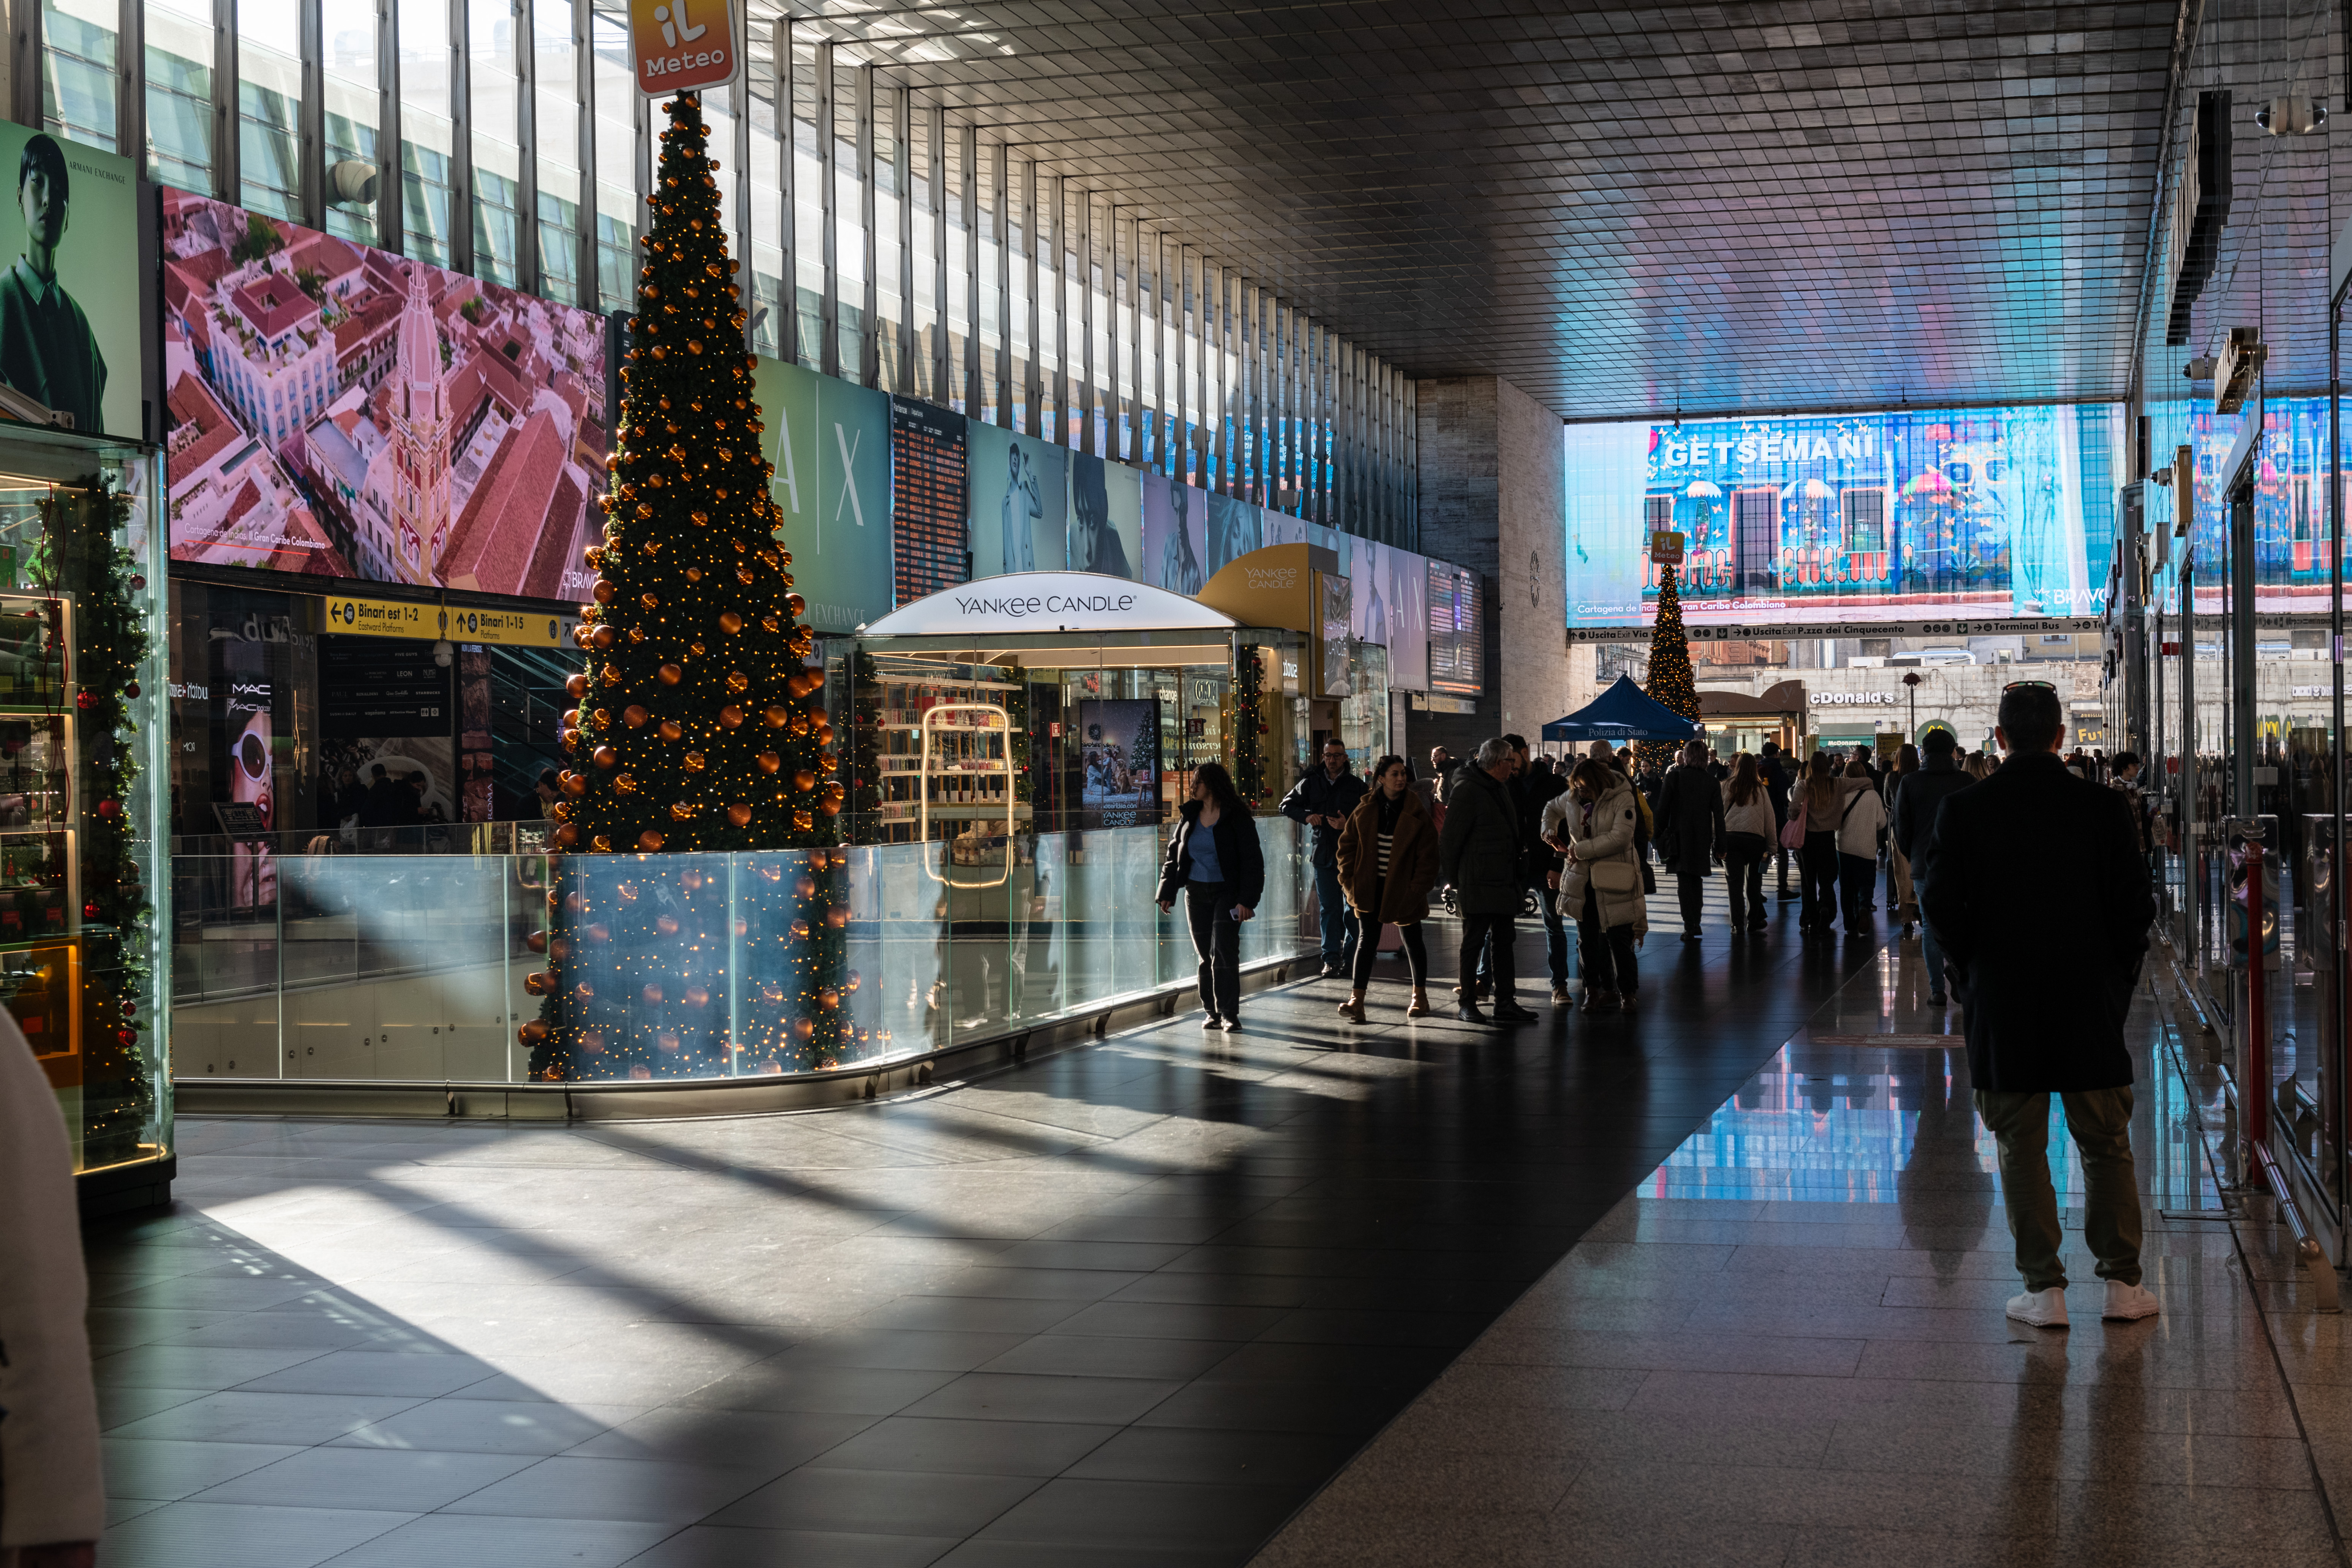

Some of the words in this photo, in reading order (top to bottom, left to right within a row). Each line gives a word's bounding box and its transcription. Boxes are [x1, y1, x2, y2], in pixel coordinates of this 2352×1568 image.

[645, 50, 724, 77] Meteo
[69, 161, 92, 174] ARMANI
[95, 168, 126, 185] EXCHANGE
[894, 403, 907, 414] Partenze
[911, 408, 923, 417] Departures
[1664, 434, 1873, 466] GETSEMANI
[185, 523, 218, 537] Cartagena
[219, 527, 227, 537] de
[229, 528, 248, 540] Indias,
[249, 531, 253, 541] Il
[254, 532, 269, 542] Gran
[270, 534, 290, 545] Caribe
[291, 536, 325, 549] Colombiano
[358, 603, 385, 618] Binari
[388, 608, 400, 620] est
[404, 607, 418, 621] 1-2
[816, 604, 865, 627] EXCHANGE
[1577, 605, 1625, 615] Cartagena
[1627, 604, 1636, 613] de
[1700, 601, 1731, 610] Caribe
[1732, 601, 1786, 610] Colombiano
[358, 621, 381, 631] Eastward
[382, 623, 404, 633] Platforms
[481, 613, 503, 628] Binari
[506, 616, 524, 630] 1-15
[1994, 622, 2038, 631] Terminal
[2042, 621, 2060, 630] Bus
[481, 631, 500, 640] Platforms
[1753, 628, 1781, 636] Uscita
[1844, 626, 1905, 636] Cinquecento
[1159, 686, 1177, 704] change
[1810, 691, 1894, 704] cDonald's
[1589, 728, 1615, 736] Polizia
[1617, 727, 1625, 736] di
[1627, 727, 1648, 736] Stato
